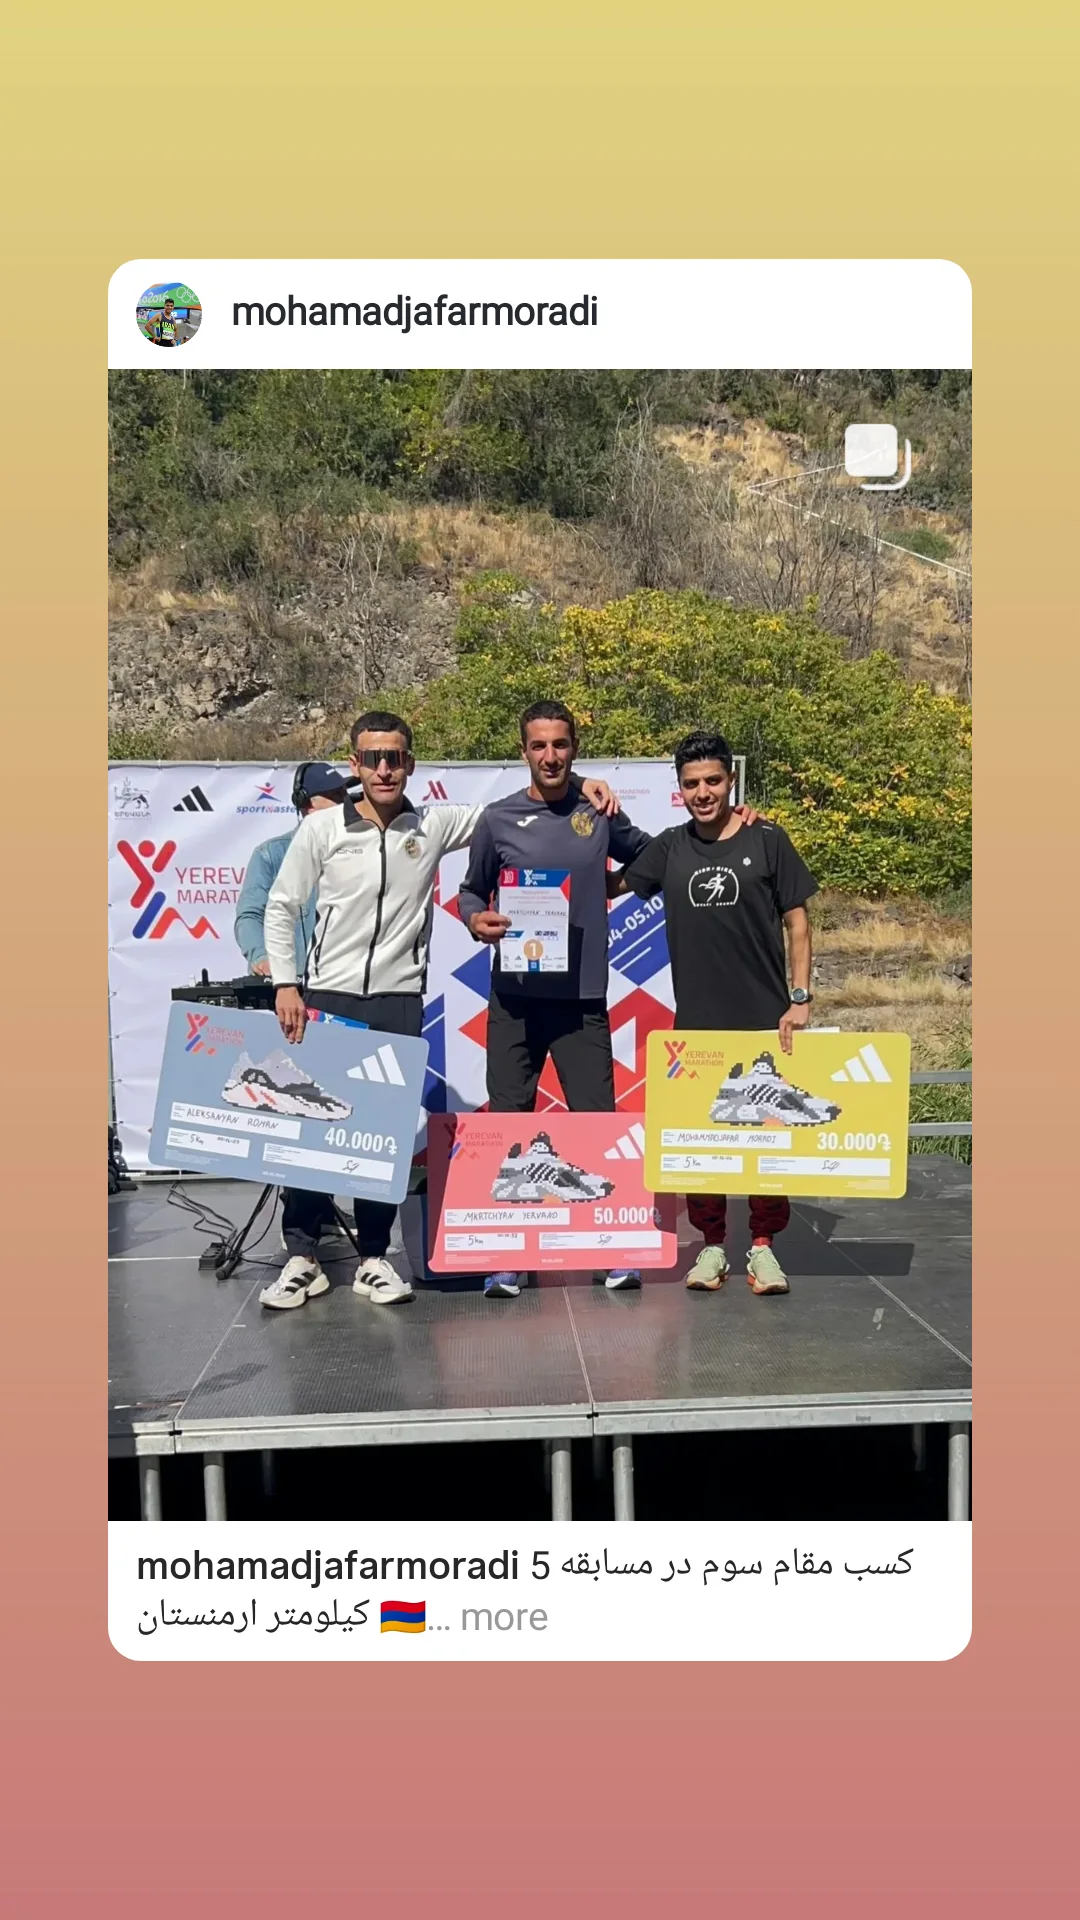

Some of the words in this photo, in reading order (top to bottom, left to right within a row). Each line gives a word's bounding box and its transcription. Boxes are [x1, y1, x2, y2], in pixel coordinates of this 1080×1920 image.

[174, 867, 245, 885] YEREV
[177, 889, 240, 904] MARAT
[685, 1050, 724, 1059] YEREVAN
[465, 1131, 503, 1140] YEREVAN
